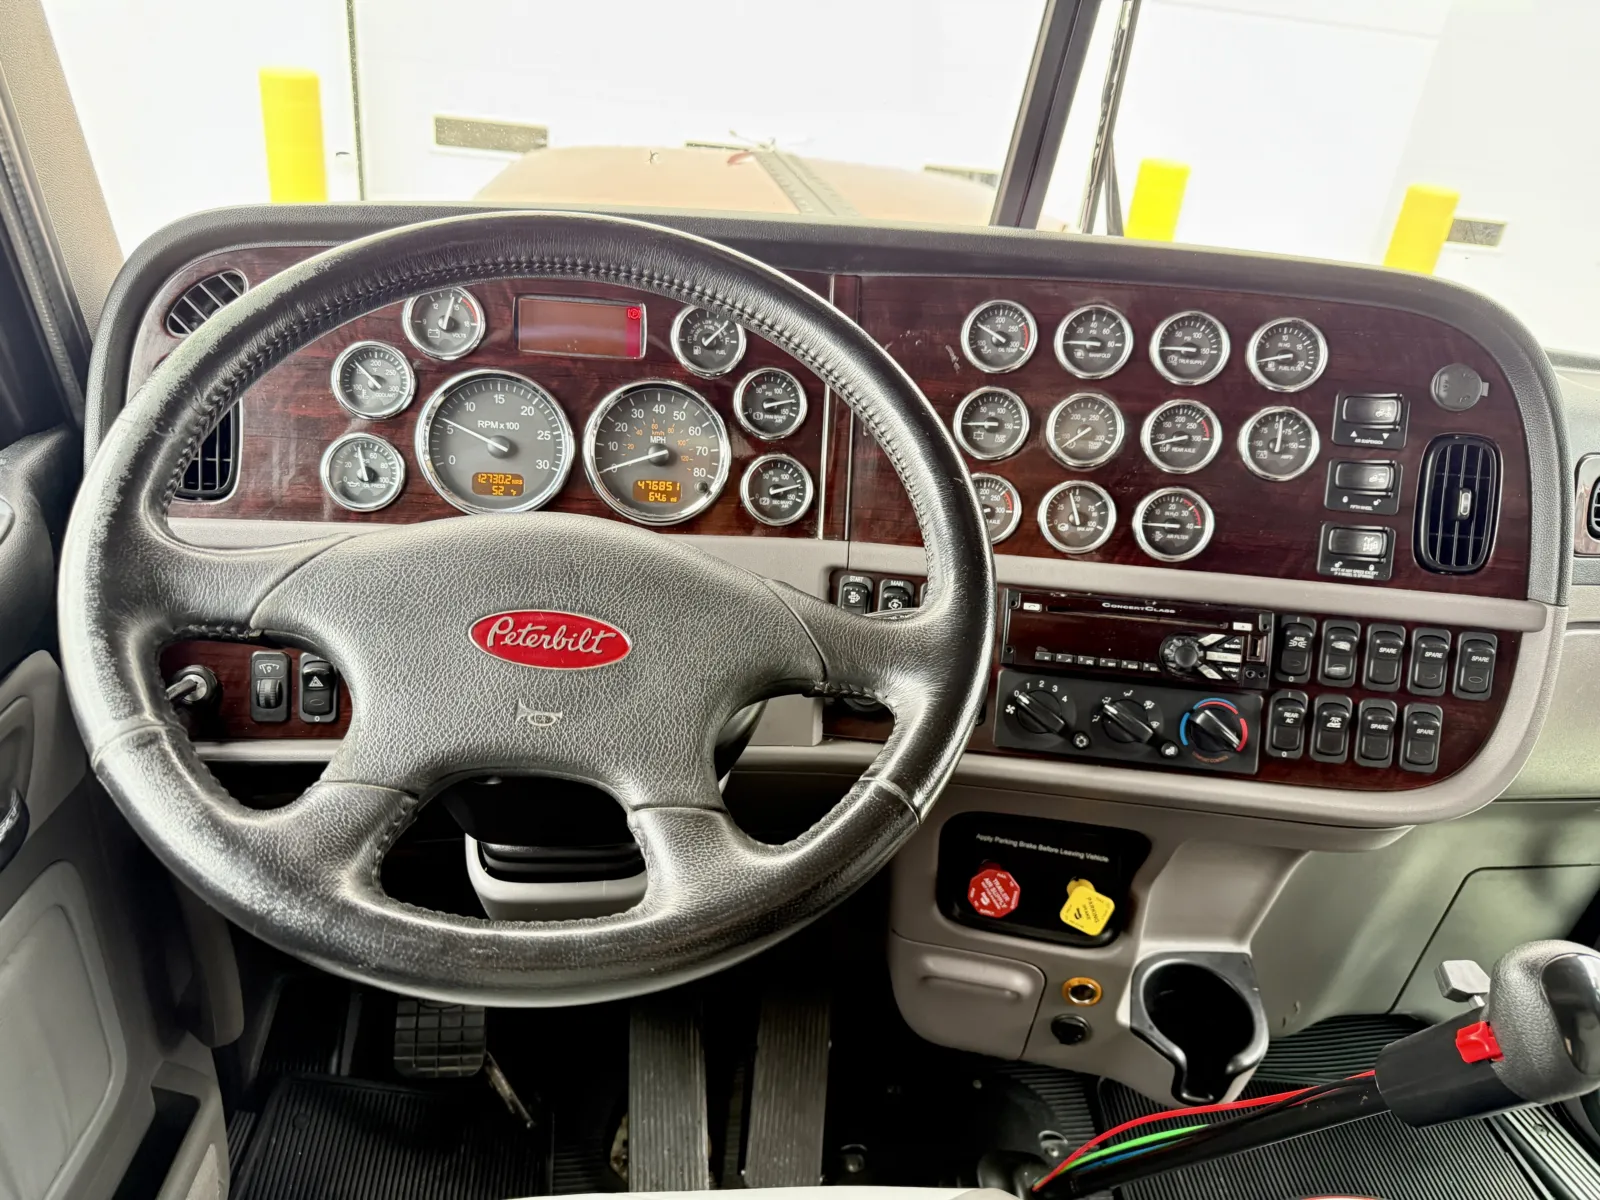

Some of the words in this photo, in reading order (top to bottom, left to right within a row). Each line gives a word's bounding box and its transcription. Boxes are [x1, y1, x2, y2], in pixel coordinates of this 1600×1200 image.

[995, 316, 1006, 324] 200
[725, 337, 730, 345] F
[493, 394, 505, 404] 15
[464, 401, 476, 412] 10
[520, 406, 535, 416] 20
[652, 404, 666, 414] 40
[631, 408, 644, 419] 30
[673, 410, 686, 421] 50
[446, 425, 454, 435] 5
[477, 420, 499, 429] RPM
[505, 421, 520, 431] 100
[614, 422, 628, 432] 20
[537, 430, 551, 441] 25
[688, 426, 702, 436] 60
[649, 436, 666, 444] MPH
[608, 441, 619, 451] 10
[695, 446, 709, 456] 70
[448, 455, 456, 465] 0
[535, 459, 550, 470] 30
[693, 467, 706, 477] 80
[477, 473, 512, 485] 12730.2
[491, 485, 505, 496] 52
[637, 480, 680, 491] 476851
[648, 492, 667, 502] 64.6
[486, 616, 617, 654] Peterbilt
[1424, 651, 1443, 659] SPARE
[1471, 655, 1490, 663] SPARE
[1038, 680, 1045, 688] 2
[1052, 684, 1058, 692] 3
[1061, 695, 1068, 703] 4
[1370, 723, 1389, 731] SPARE
[1416, 728, 1435, 736] SPARE
[976, 833, 994, 843] Apply
[994, 836, 1018, 848] Parking
[1018, 841, 1037, 850] Brake
[1038, 844, 1059, 854] Before
[1060, 848, 1085, 860] Leaving
[1085, 852, 1109, 863] Vehicle
[983, 877, 993, 888] AIR
[990, 887, 1008, 909] SUPPLY
[993, 877, 1010, 902] TRAILER
[1082, 904, 1092, 921] BRAKE
[1086, 896, 1100, 924] PARKING
